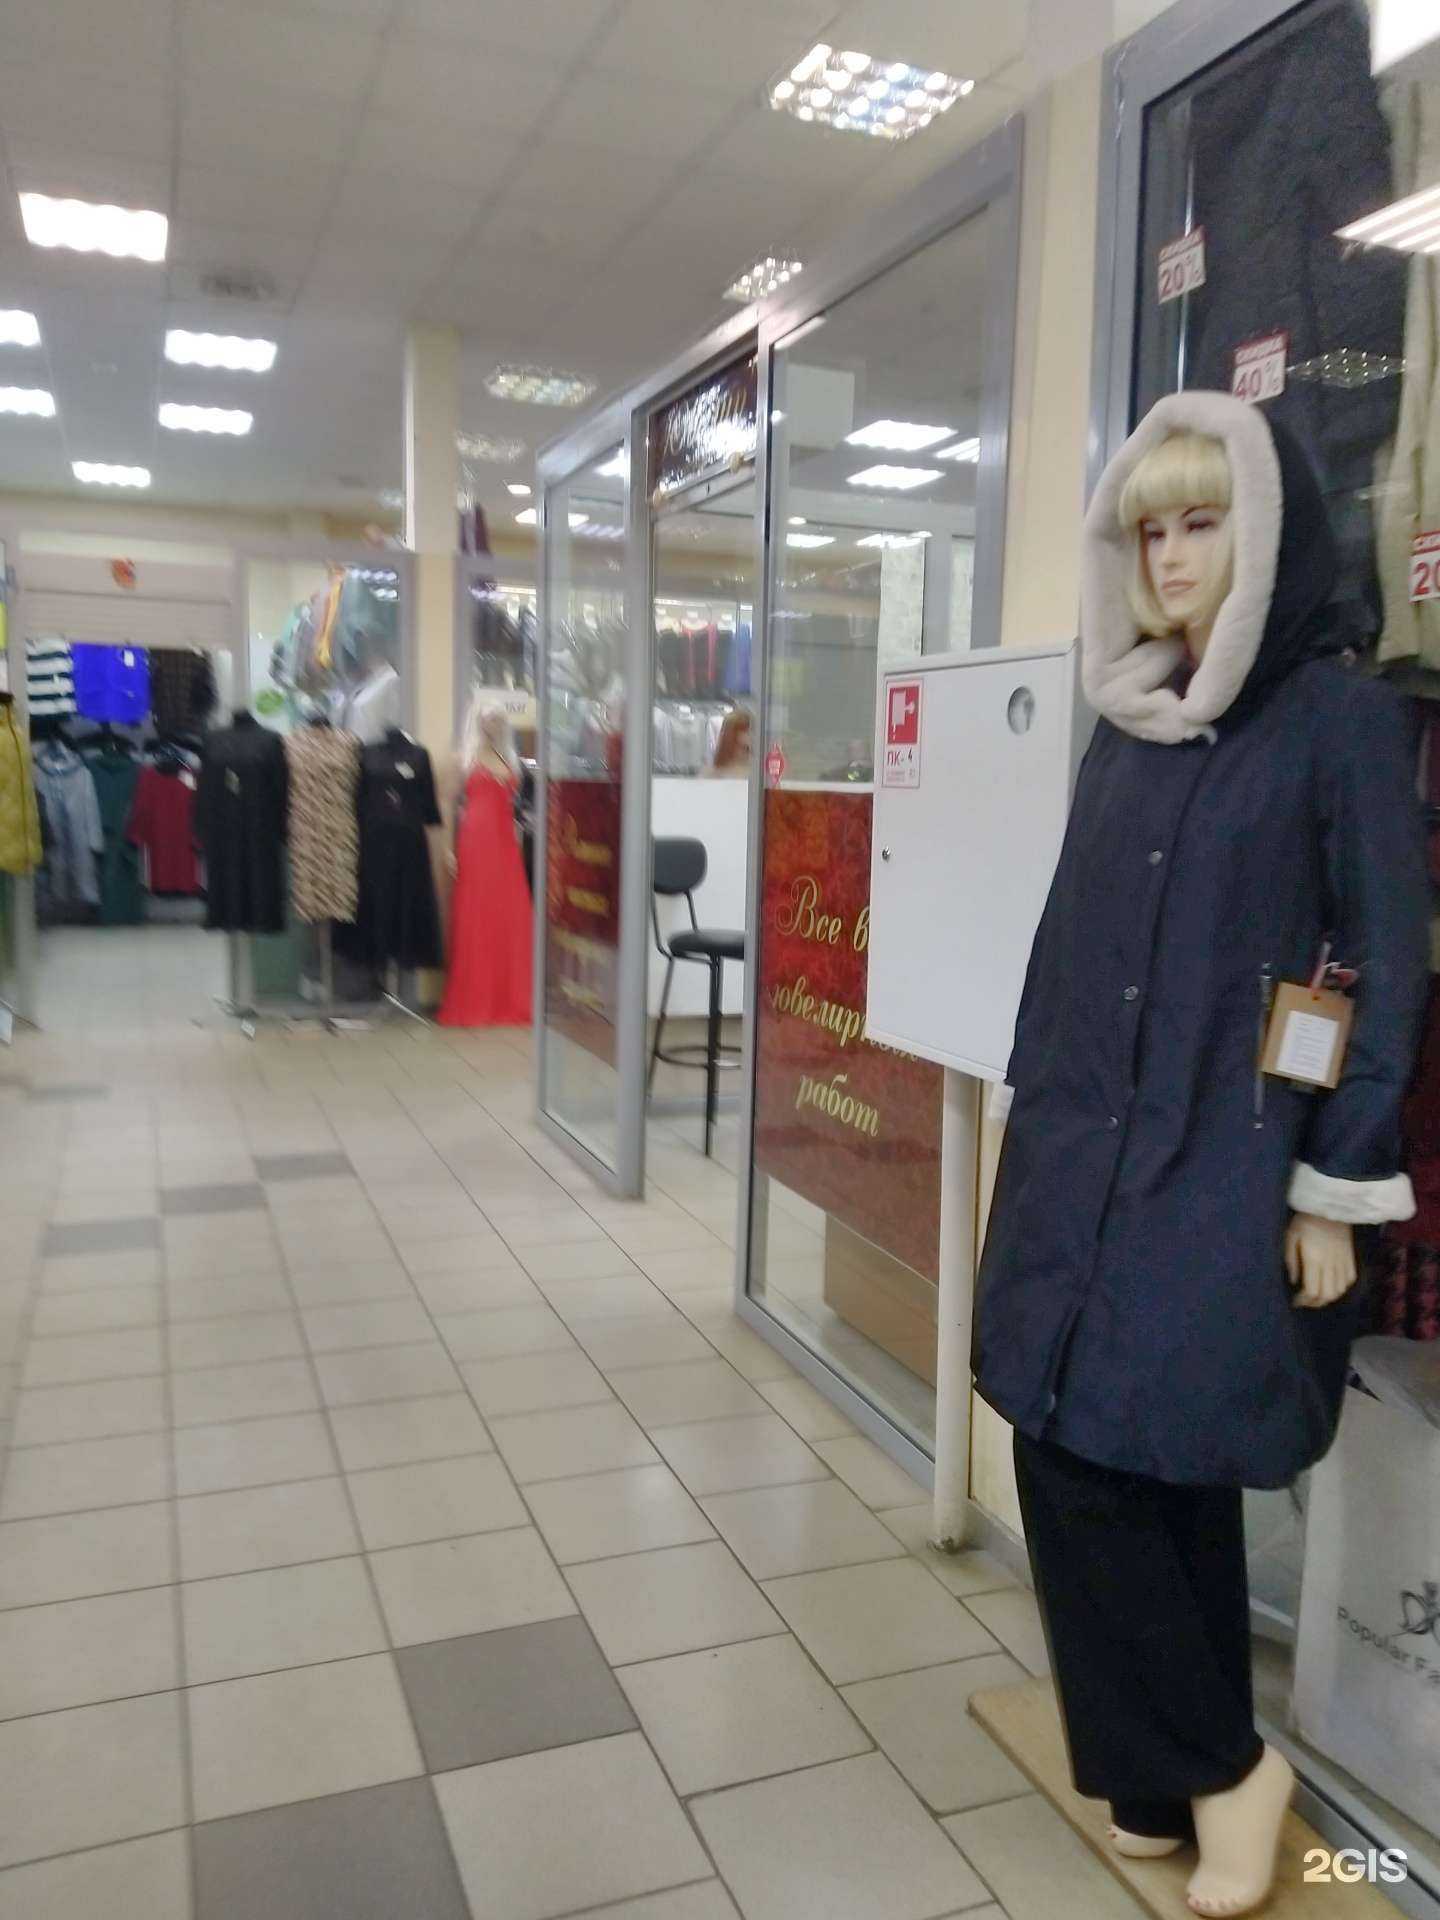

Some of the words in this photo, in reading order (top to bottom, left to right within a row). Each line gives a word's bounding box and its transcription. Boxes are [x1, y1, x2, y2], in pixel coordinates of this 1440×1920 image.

[774, 875, 842, 945] Все
[766, 975, 920, 1063] ювелир
[795, 1073, 880, 1137] работ
